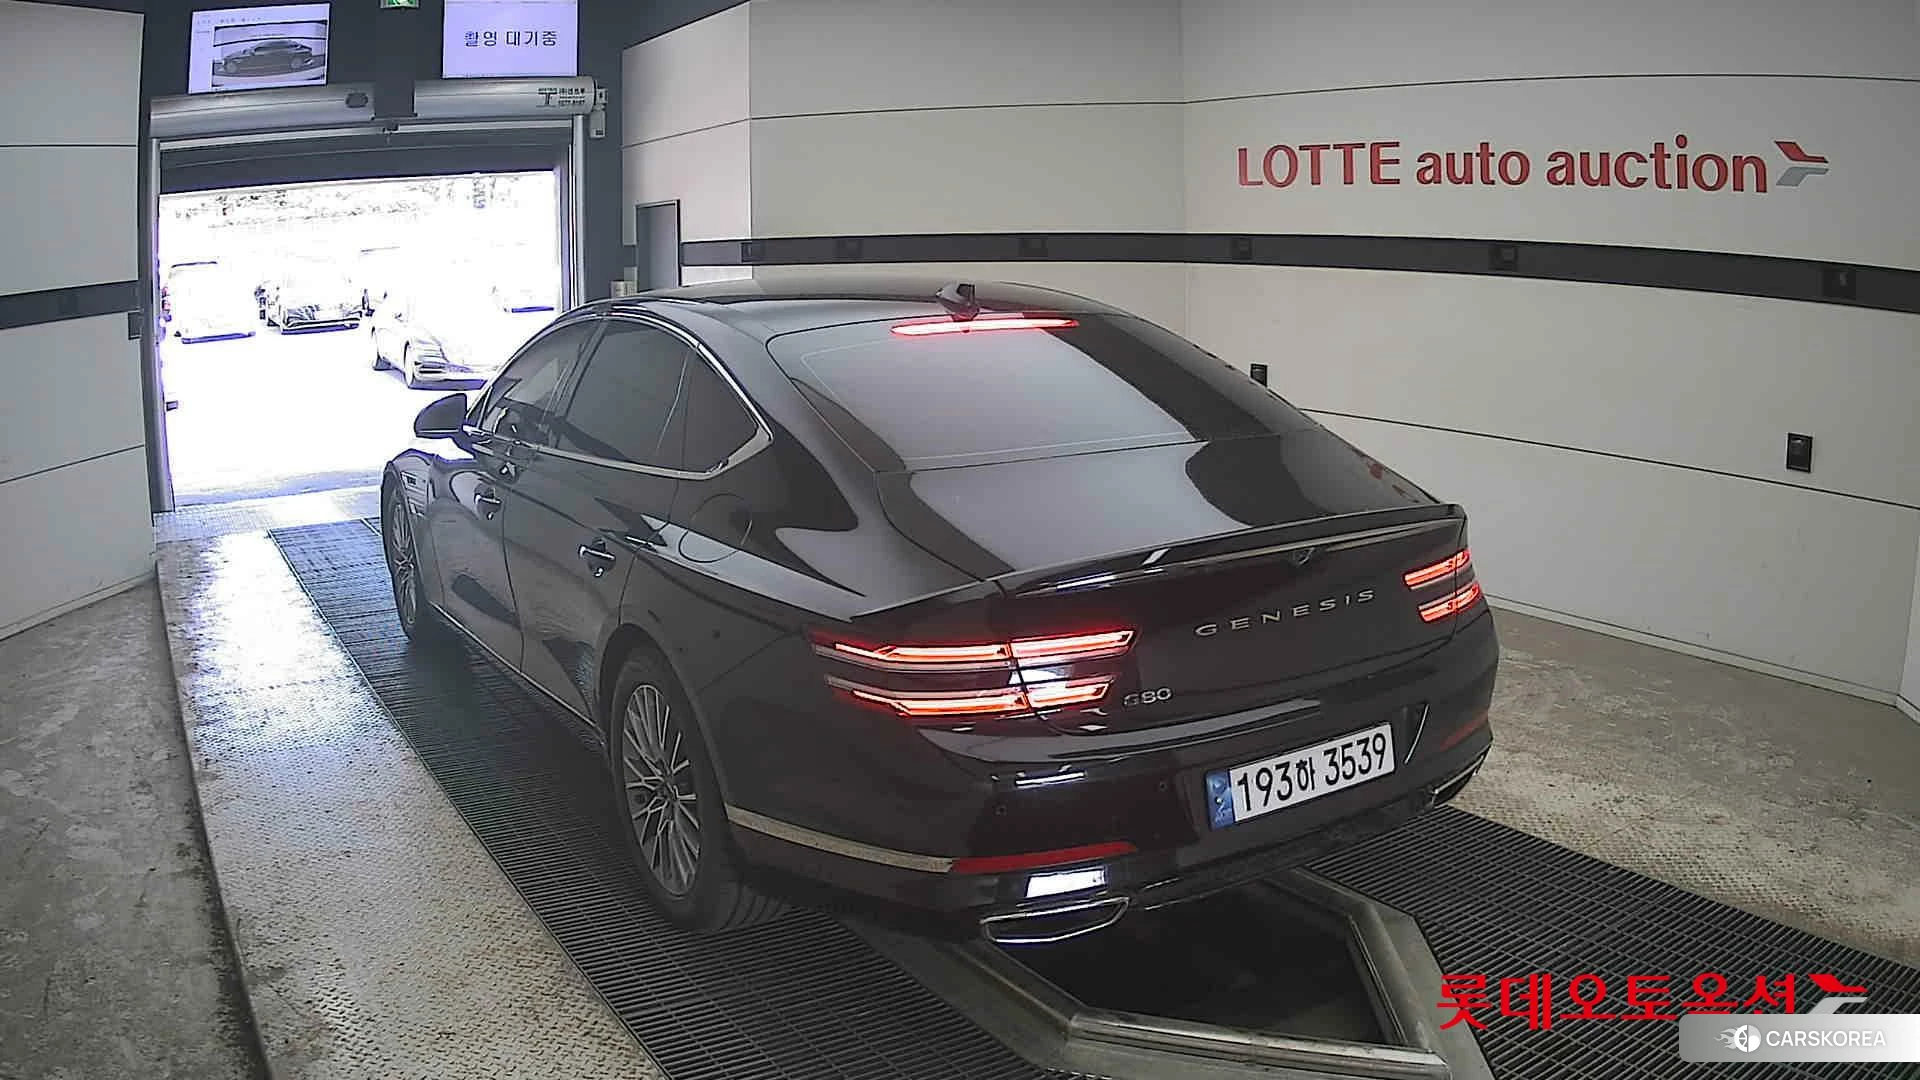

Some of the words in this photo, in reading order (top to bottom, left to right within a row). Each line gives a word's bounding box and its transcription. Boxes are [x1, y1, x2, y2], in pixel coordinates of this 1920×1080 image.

[504, 30, 558, 47] 대기중
[1237, 141, 1401, 187] LOTTE
[1416, 141, 1531, 186] auto
[1545, 134, 1767, 193] auction
[1195, 589, 1375, 636] GENESIS
[1123, 687, 1173, 707] G80
[1237, 757, 1316, 812] 193하
[1322, 732, 1387, 786] 3539
